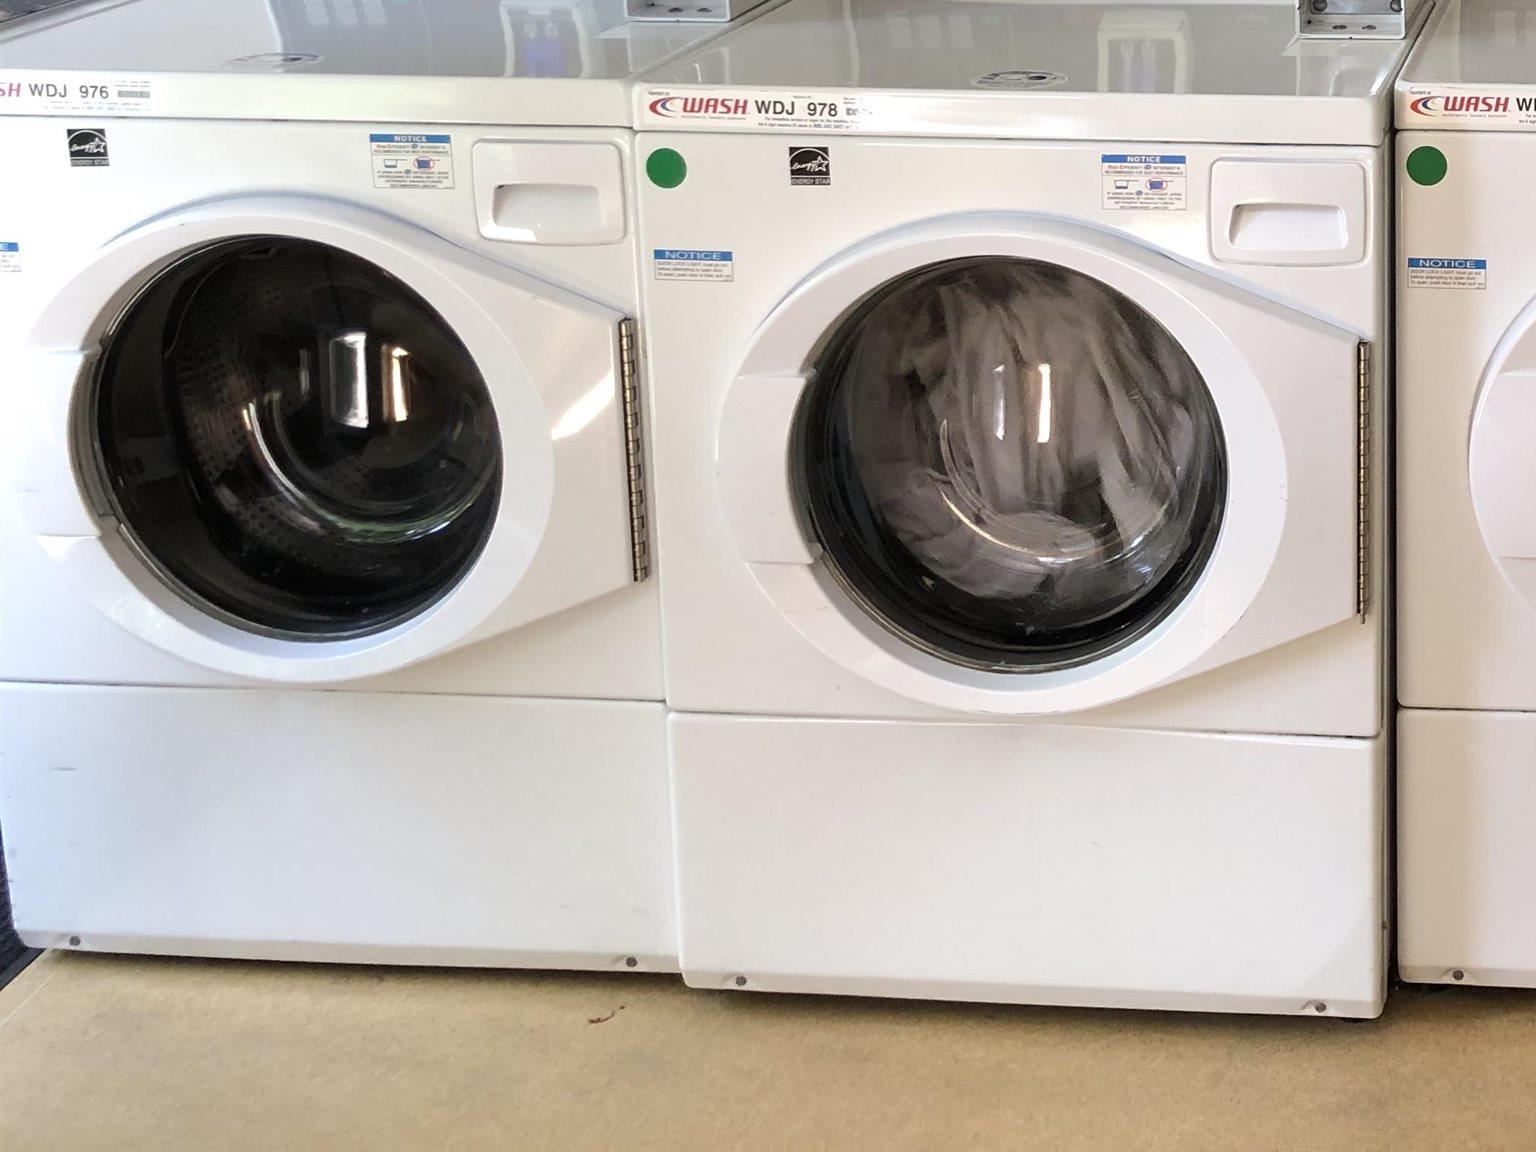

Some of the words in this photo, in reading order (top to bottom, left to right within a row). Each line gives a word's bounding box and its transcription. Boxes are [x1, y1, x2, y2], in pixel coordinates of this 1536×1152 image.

[29, 83, 67, 98] WDJ
[79, 85, 109, 99] 976
[682, 98, 748, 116] WASH
[755, 100, 795, 115] WDJ
[807, 103, 838, 117] 978
[1443, 96, 1510, 113] WASH
[1126, 155, 1162, 163] NOTICE
[665, 250, 722, 260] NOTICE
[1419, 259, 1476, 268] NOTICE
